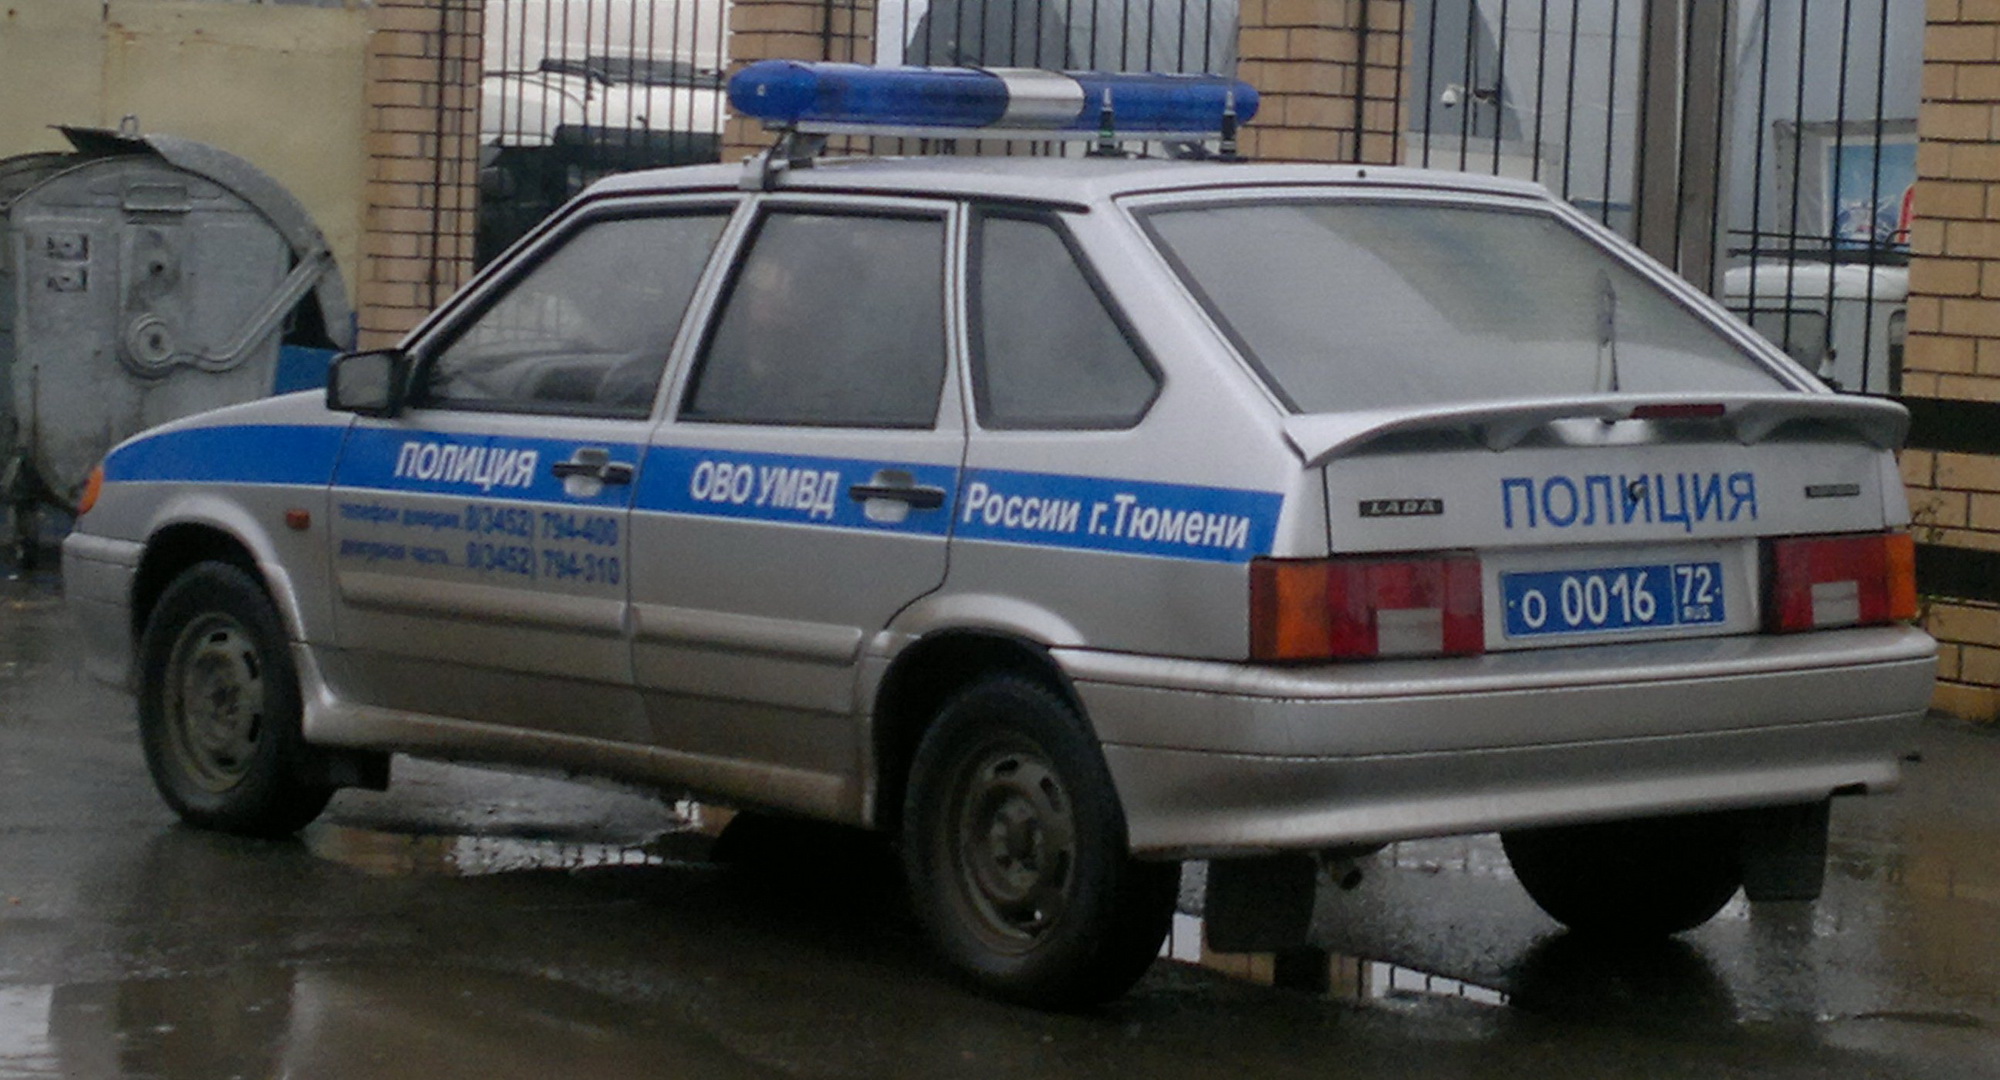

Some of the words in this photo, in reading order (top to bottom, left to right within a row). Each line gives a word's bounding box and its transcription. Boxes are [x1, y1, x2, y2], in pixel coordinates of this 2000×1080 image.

[394, 442, 538, 491] ПОЛИЦИЯ
[690, 460, 755, 505] ОВО
[755, 466, 840, 520] УМВД
[963, 482, 1082, 533] России
[1088, 494, 1250, 549] г.Тюмени
[1368, 499, 1437, 516] LADA
[1500, 472, 1758, 533] ПОЛИЦИЯ
[543, 550, 621, 586] 794-310
[1560, 571, 1656, 627] 0016
[1676, 566, 1714, 604] 72
[1682, 604, 1712, 621] RUS
